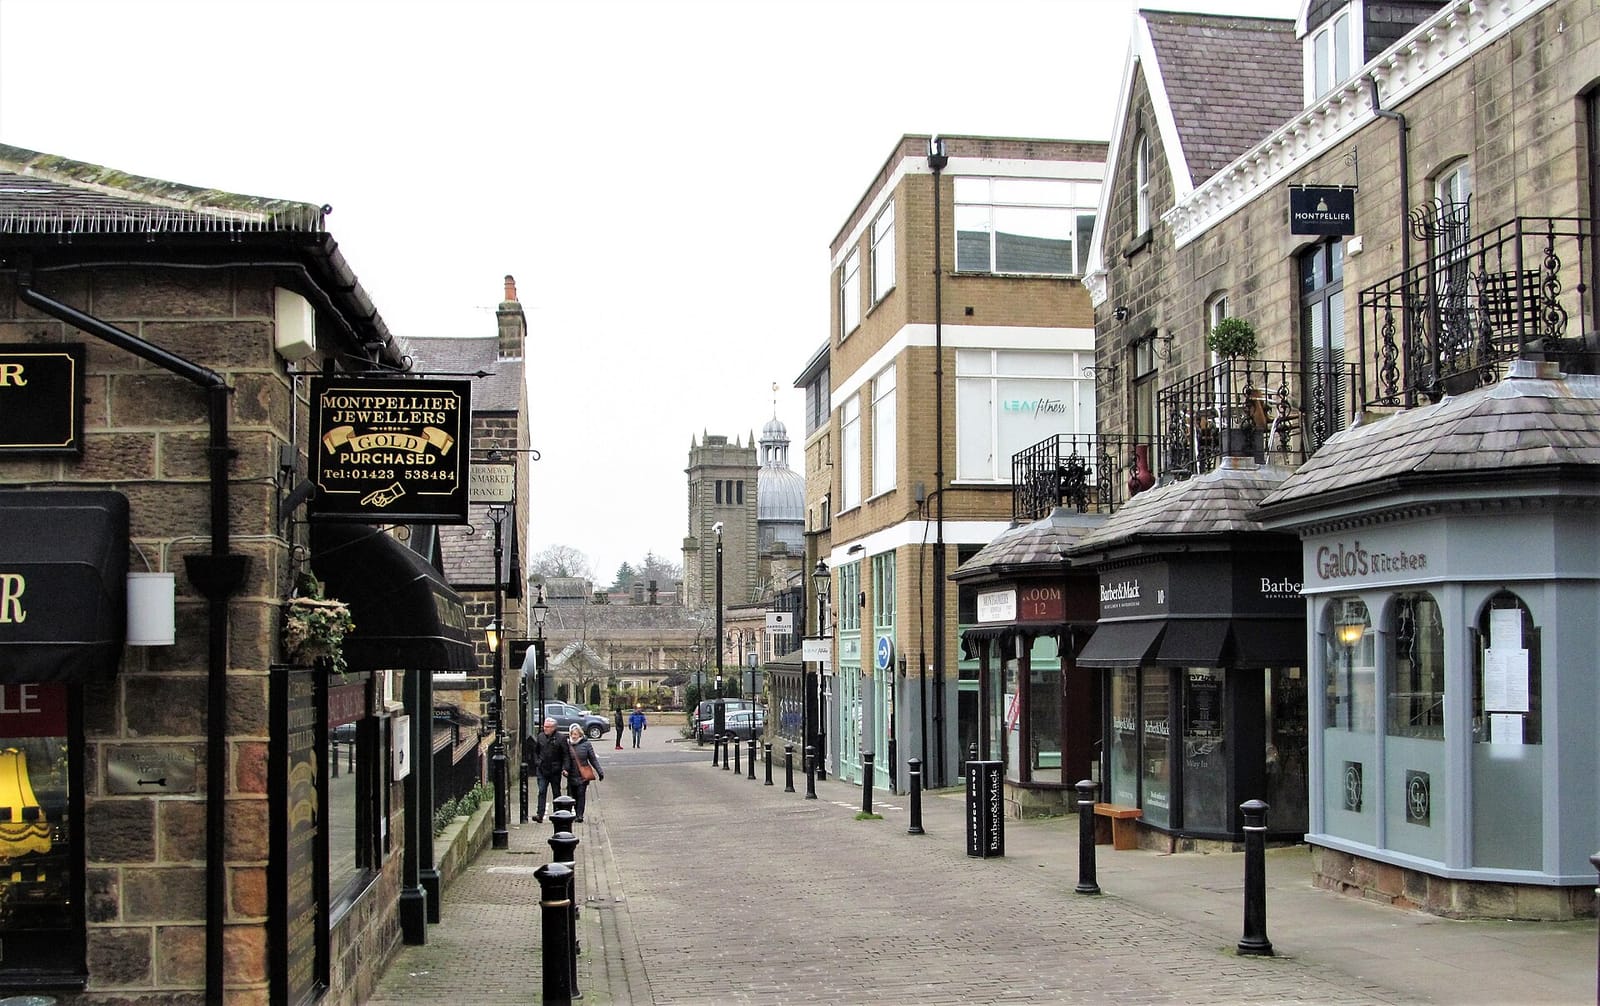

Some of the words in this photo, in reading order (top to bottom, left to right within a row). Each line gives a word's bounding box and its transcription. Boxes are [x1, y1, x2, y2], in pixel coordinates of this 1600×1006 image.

[323, 396, 457, 411] MONTPELLIER
[332, 411, 446, 424] JEWELLERS
[358, 434, 418, 450] GOLD
[340, 453, 436, 465] PURCHASED
[404, 470, 455, 480] 538484
[478, 475, 509, 483] MARKET
[1317, 541, 1369, 580] Galo's
[1371, 551, 1427, 573] Kitchen
[1100, 579, 1140, 601] Barber&Mack
[1034, 602, 1047, 615] 12
[990, 769, 998, 850] Barber&Mack
